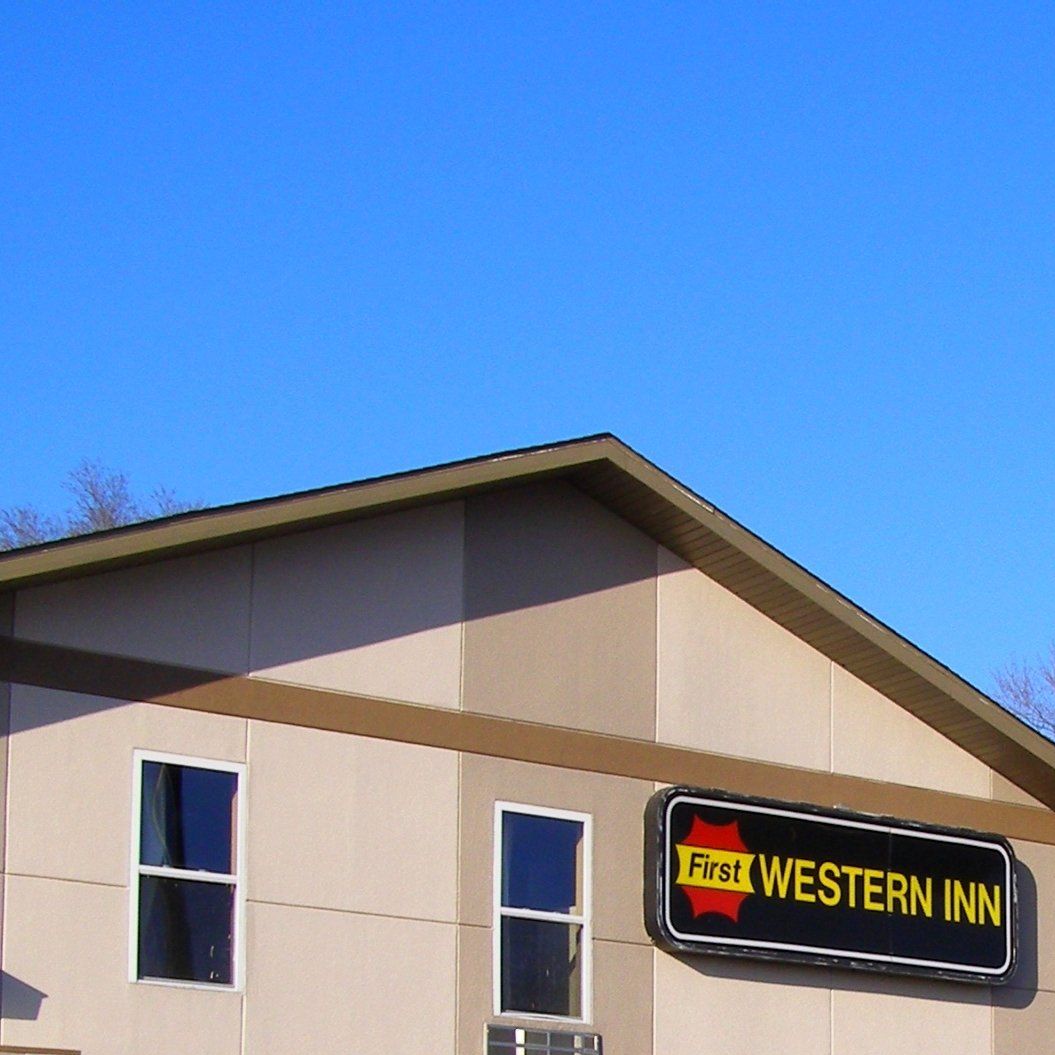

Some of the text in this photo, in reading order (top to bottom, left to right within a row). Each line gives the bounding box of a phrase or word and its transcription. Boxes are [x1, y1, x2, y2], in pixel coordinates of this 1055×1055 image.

[688, 852, 1001, 927] First WESTERN INN
